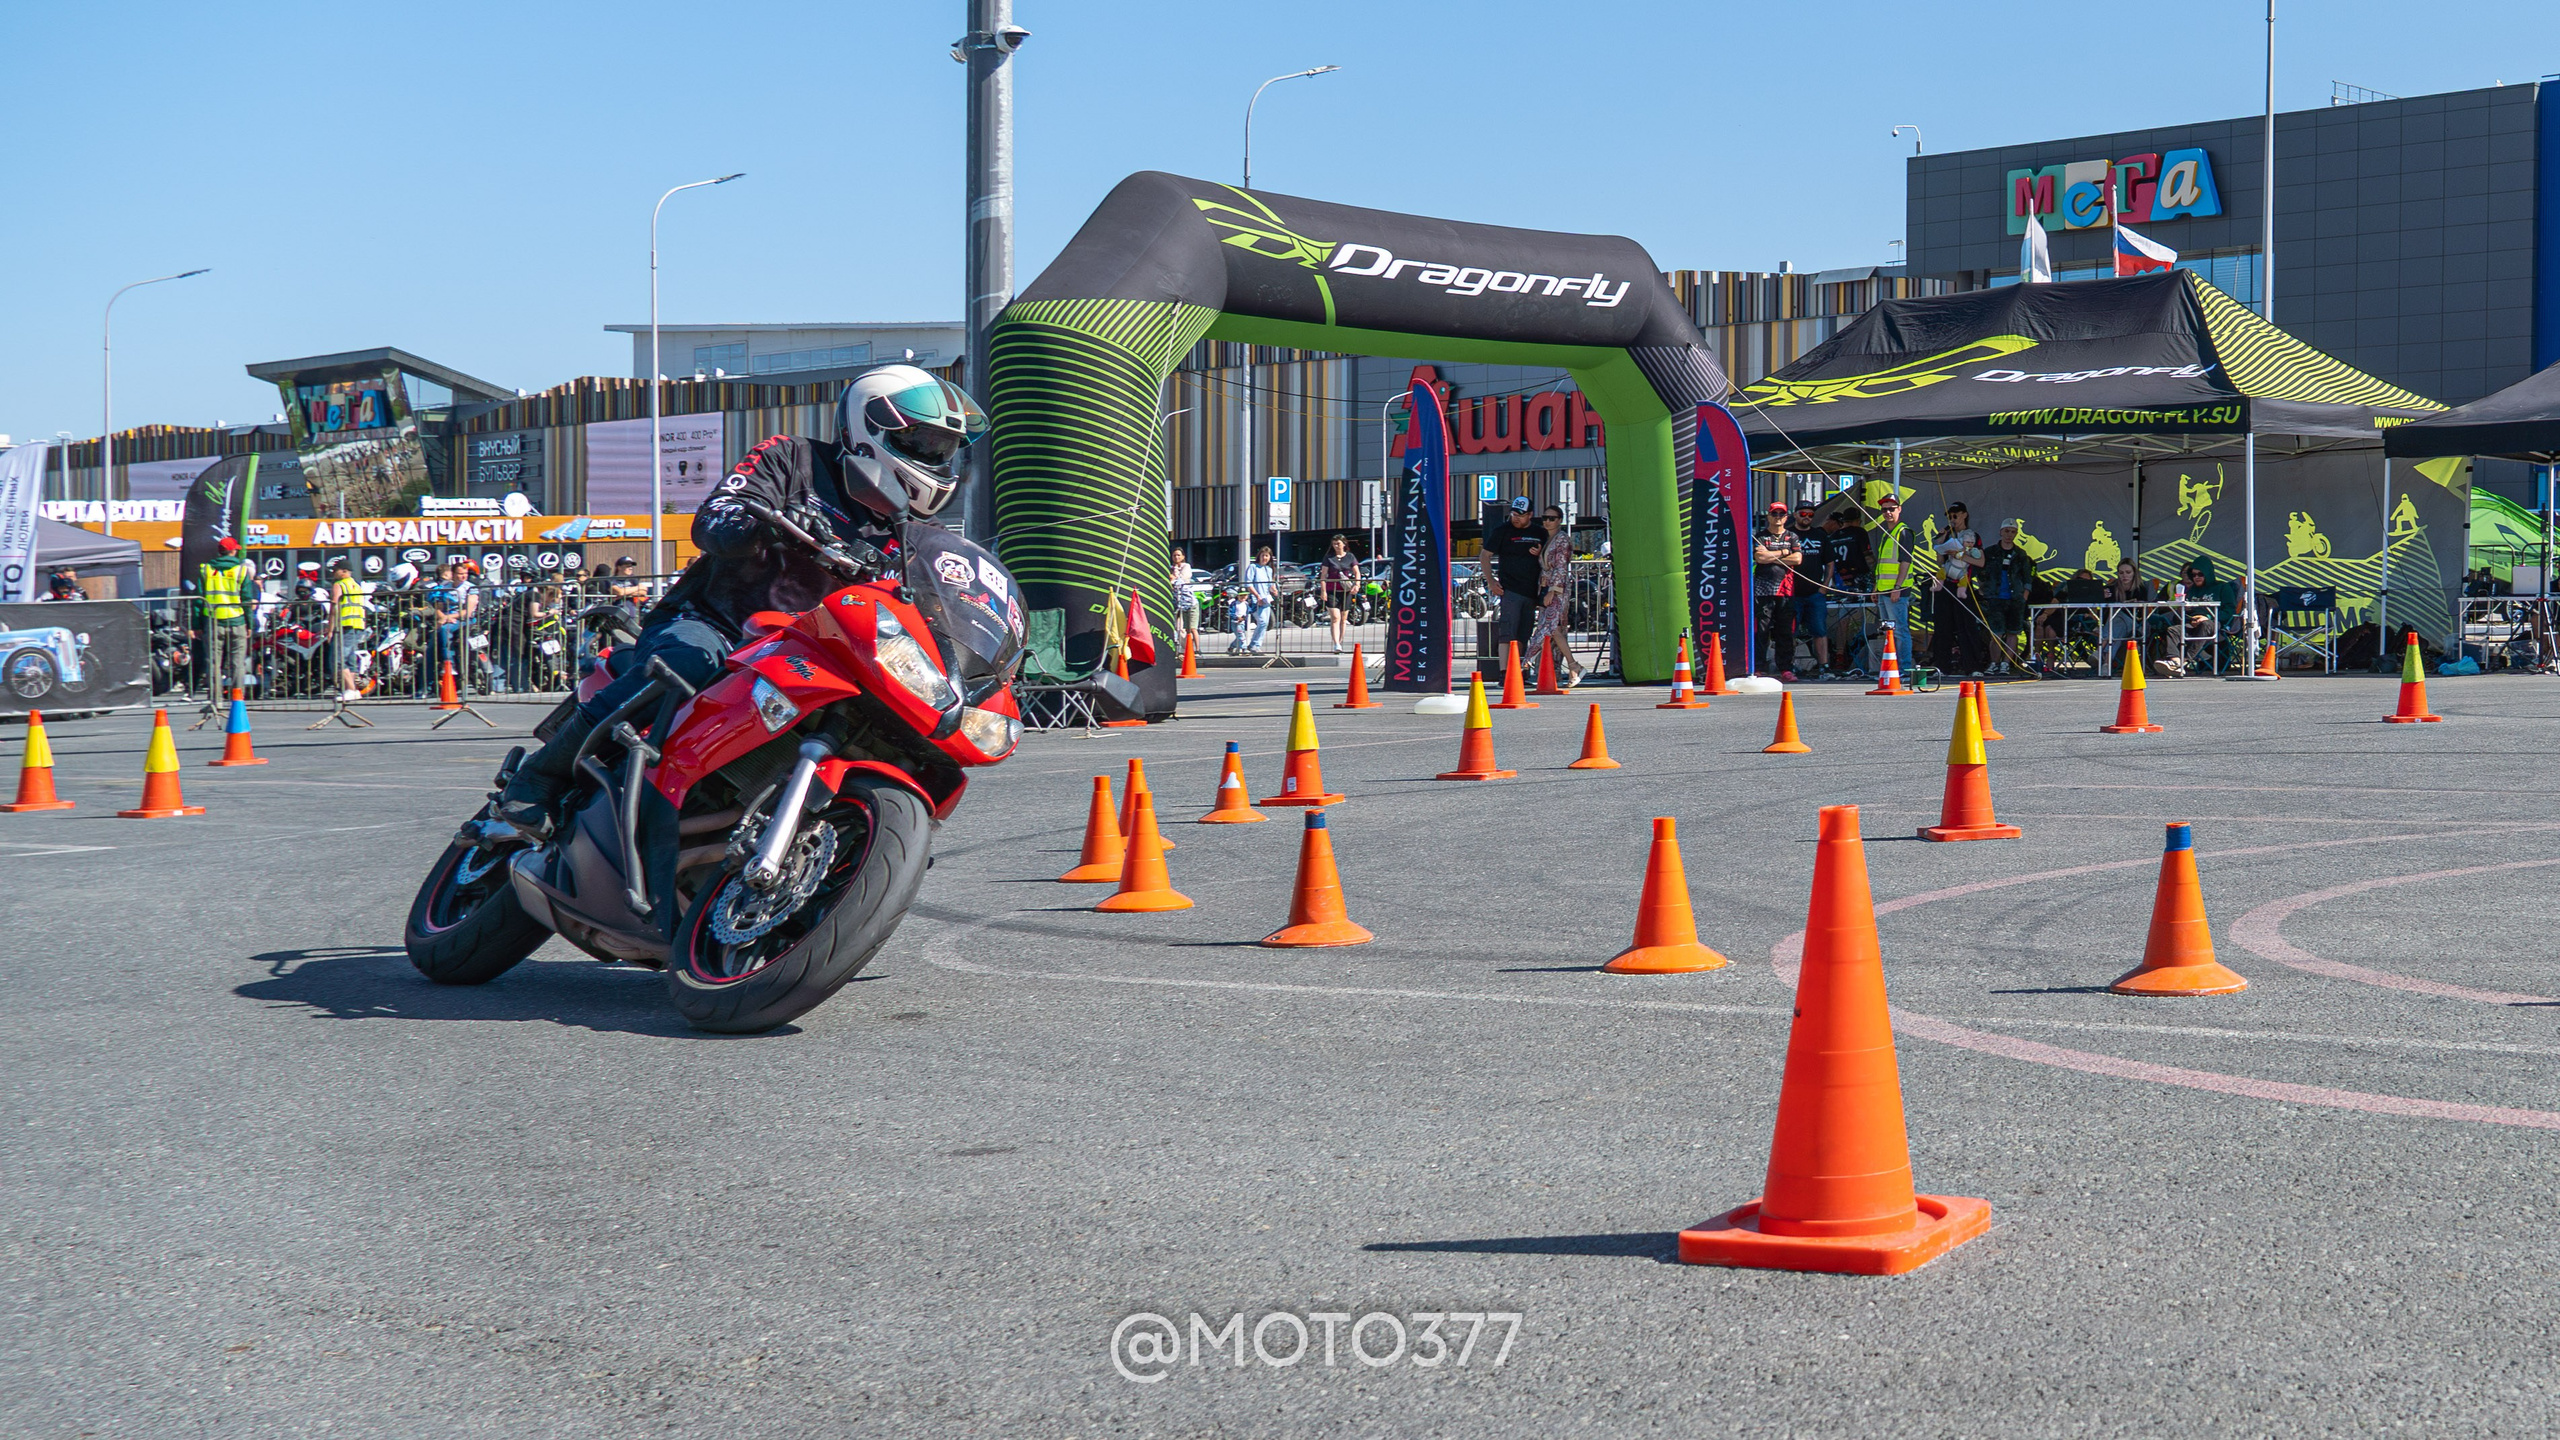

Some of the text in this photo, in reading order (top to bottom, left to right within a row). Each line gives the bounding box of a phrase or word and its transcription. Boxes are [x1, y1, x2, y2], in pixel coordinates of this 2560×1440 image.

[1328, 243, 1631, 308] Dragonfly
[1971, 362, 2218, 384] Dragonfly
[479, 433, 521, 458] ВКУСНЫЙ
[1274, 480, 1287, 500] P
[1484, 479, 1494, 498] P
[1723, 468, 1731, 514] TEAM
[3, 476, 20, 551] УВЛЕЧЁННЫХ
[589, 518, 626, 529] АВТО
[17, 509, 30, 551] ЛЮДЕЙ
[312, 518, 524, 546] АВТОЗАПЧАСТИ
[1394, 459, 1423, 682] MOTOGYMKHANA
[1417, 526, 1427, 682] EKATERINBURG
[784, 653, 816, 682] Ninja
